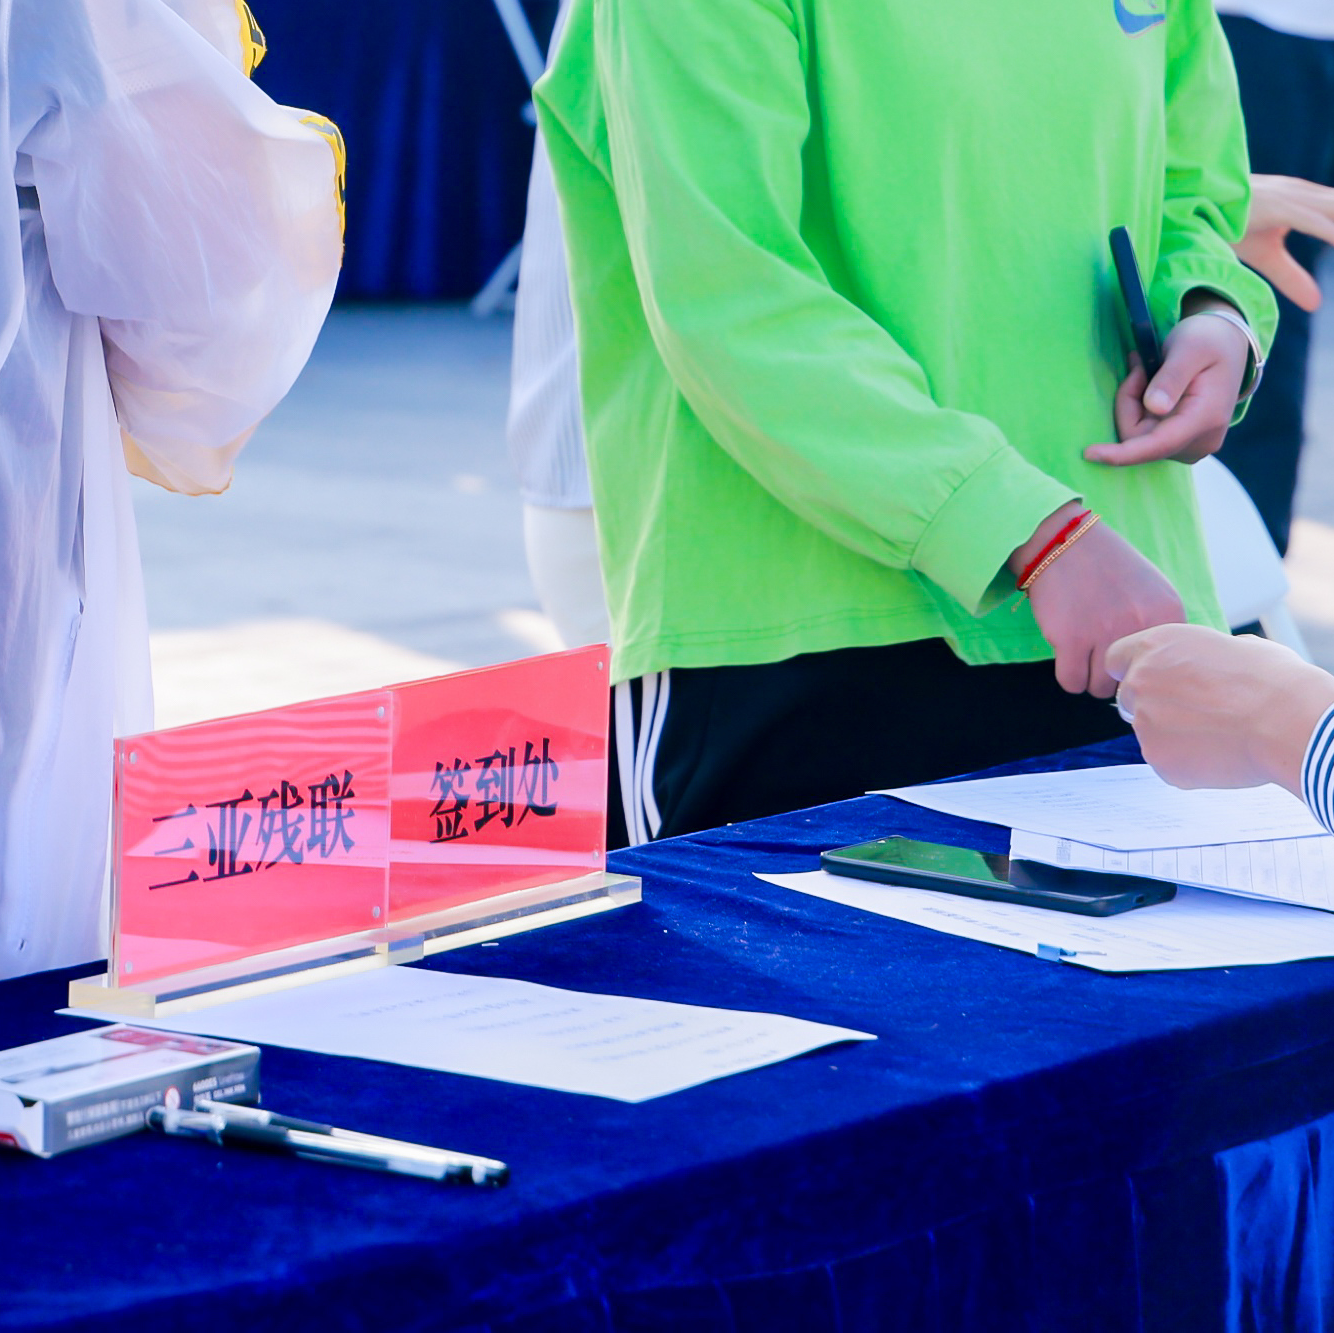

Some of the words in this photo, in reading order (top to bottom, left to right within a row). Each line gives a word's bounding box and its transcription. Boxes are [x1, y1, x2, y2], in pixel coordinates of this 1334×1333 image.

[148, 769, 356, 891] 三亚残联
[430, 737, 560, 845] 签到处
